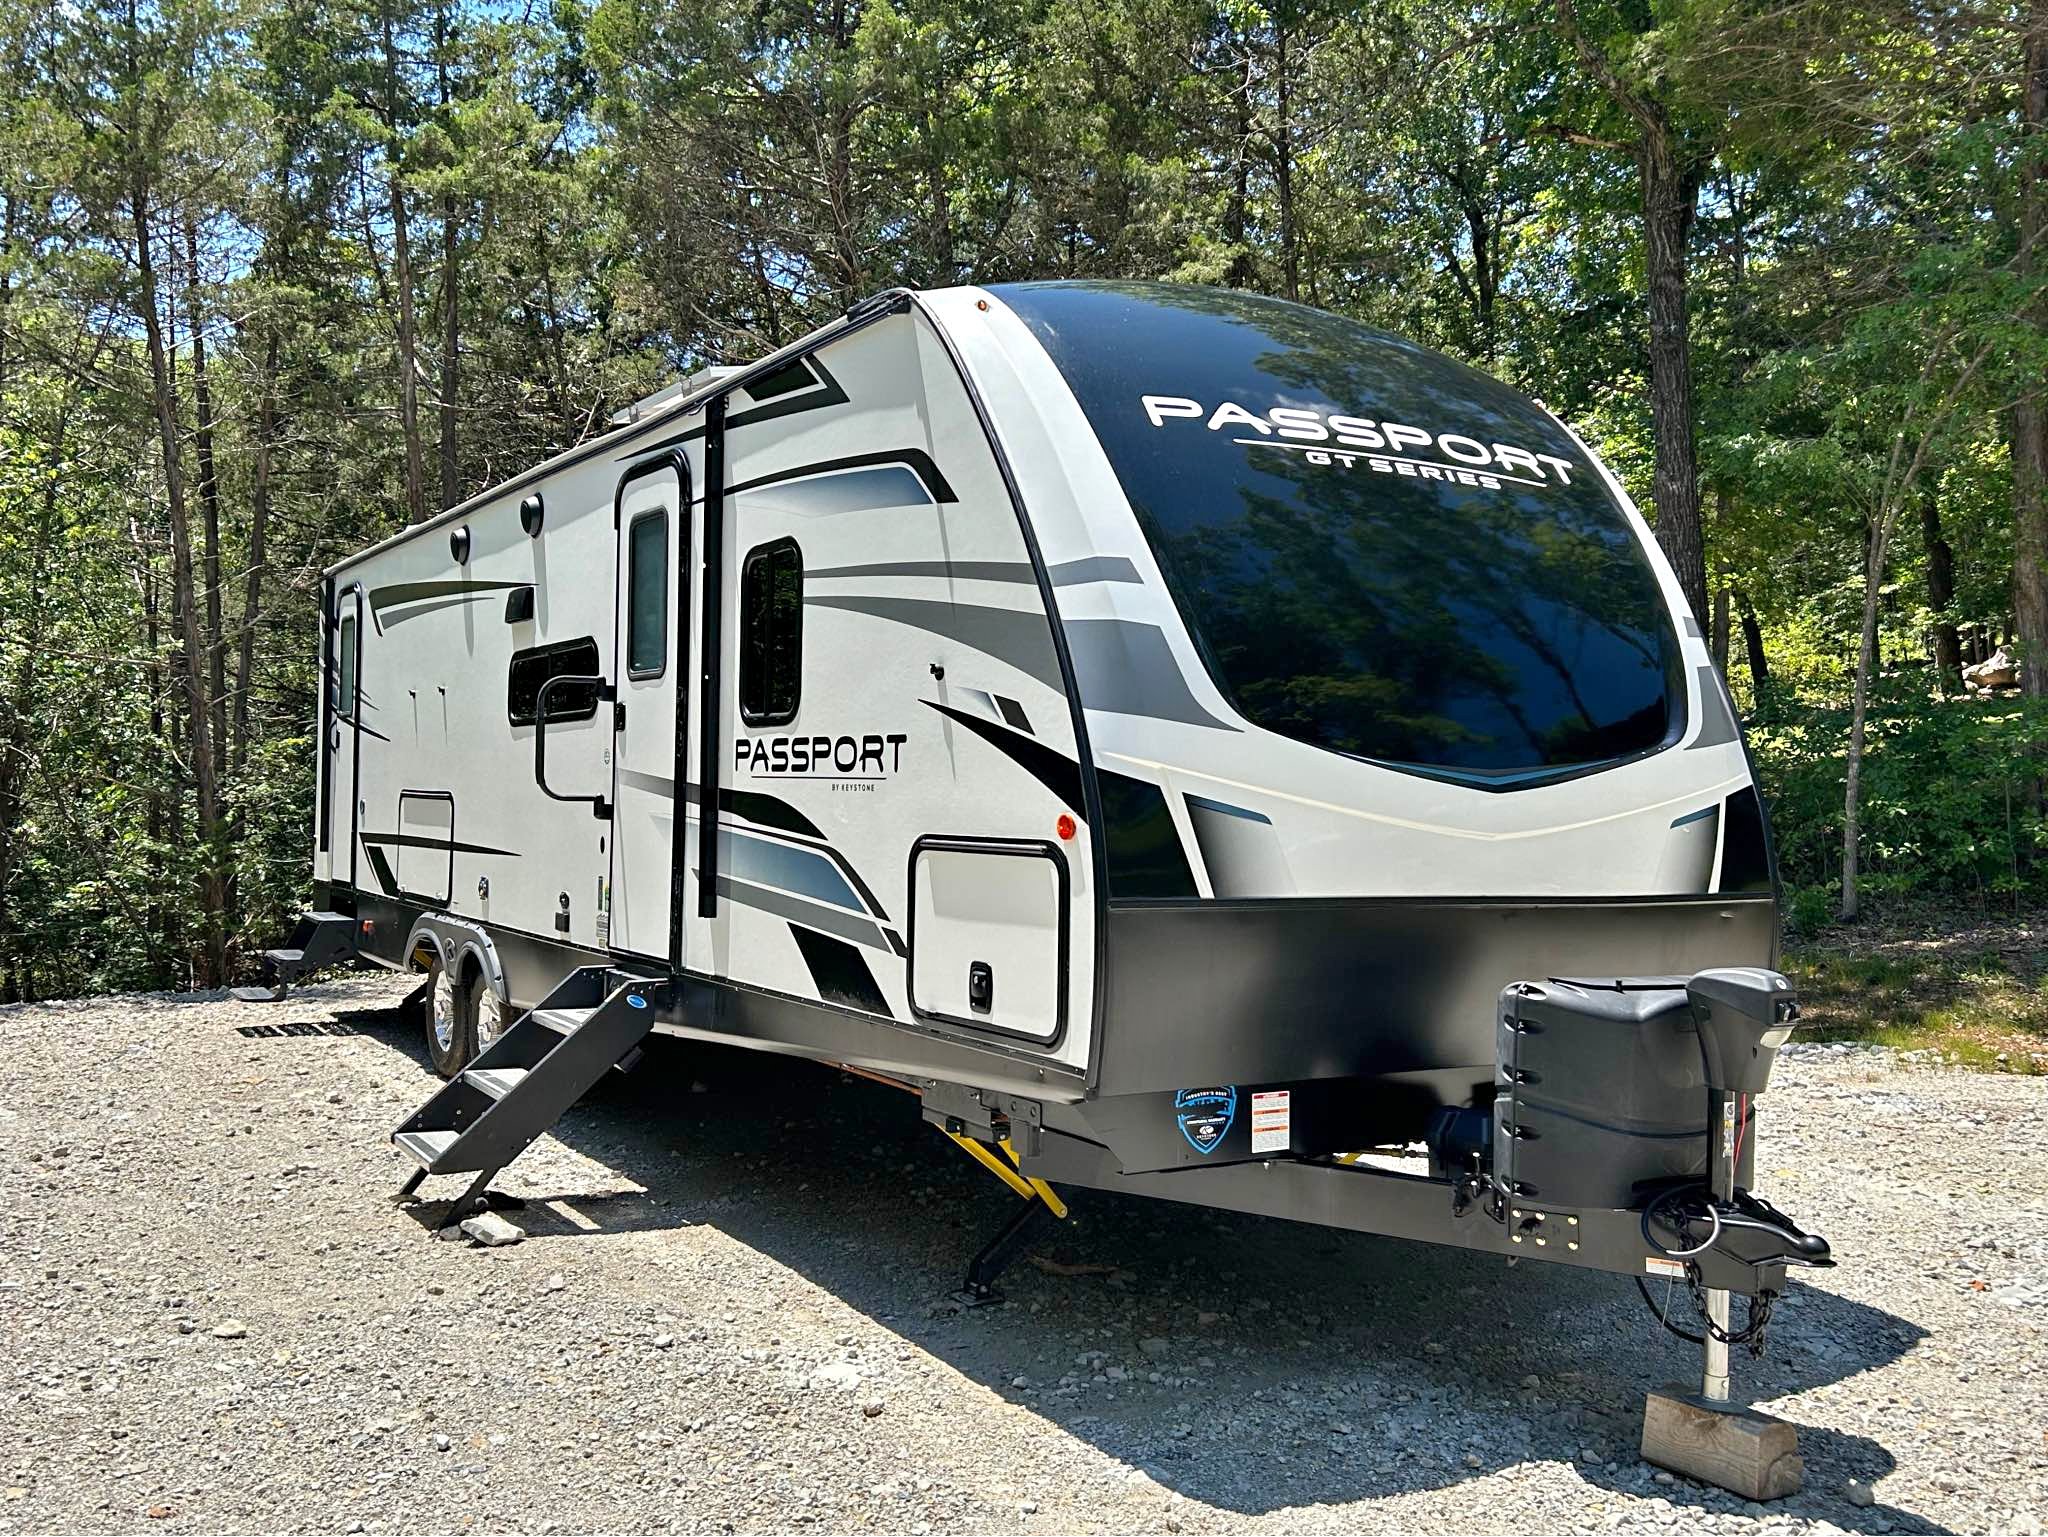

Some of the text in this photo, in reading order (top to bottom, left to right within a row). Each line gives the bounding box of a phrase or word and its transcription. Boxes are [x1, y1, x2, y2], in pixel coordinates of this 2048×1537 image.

[1141, 395, 1575, 485] PASSPORT
[1305, 451, 1502, 490] GT SERIES
[735, 733, 908, 773] PASSPORT
[831, 783, 875, 791] BY KEYSTONE
